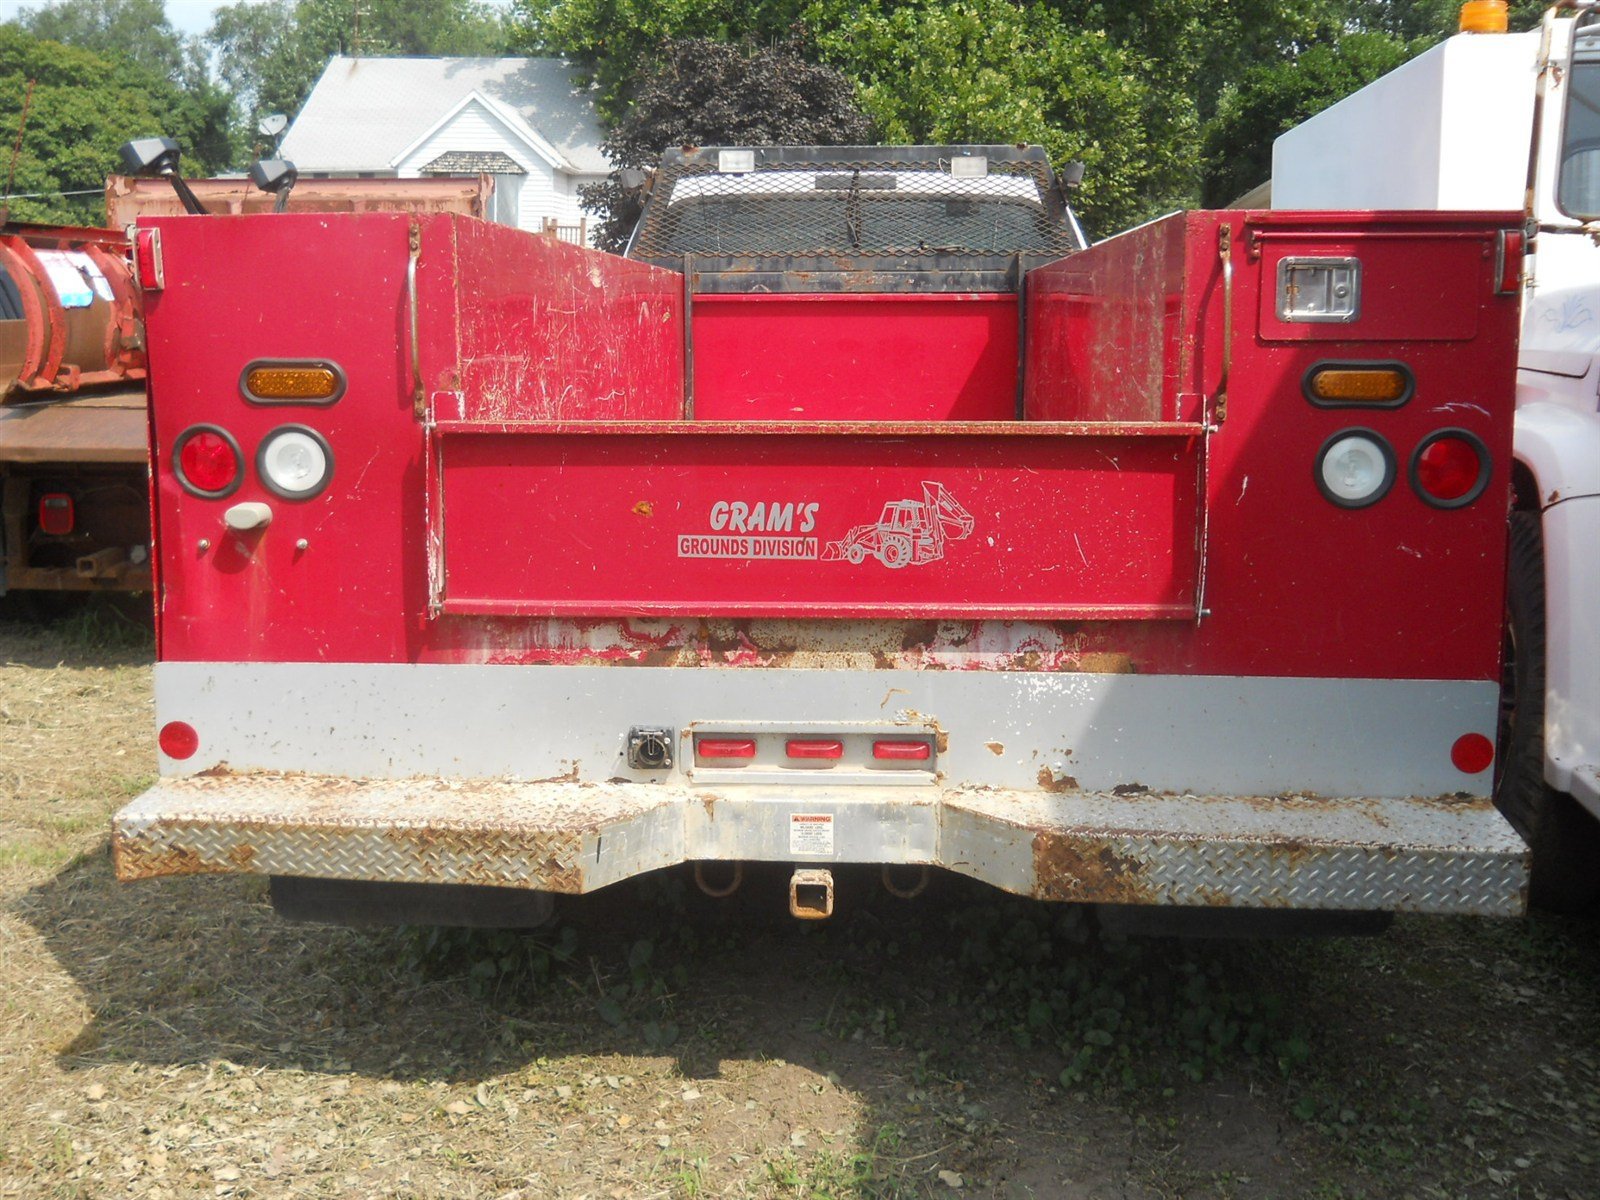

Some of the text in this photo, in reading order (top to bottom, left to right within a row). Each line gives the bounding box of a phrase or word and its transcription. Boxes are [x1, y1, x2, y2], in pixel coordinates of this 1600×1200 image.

[710, 501, 819, 534] GRAM'S
[680, 537, 815, 557] GROUNDS DIVISION
